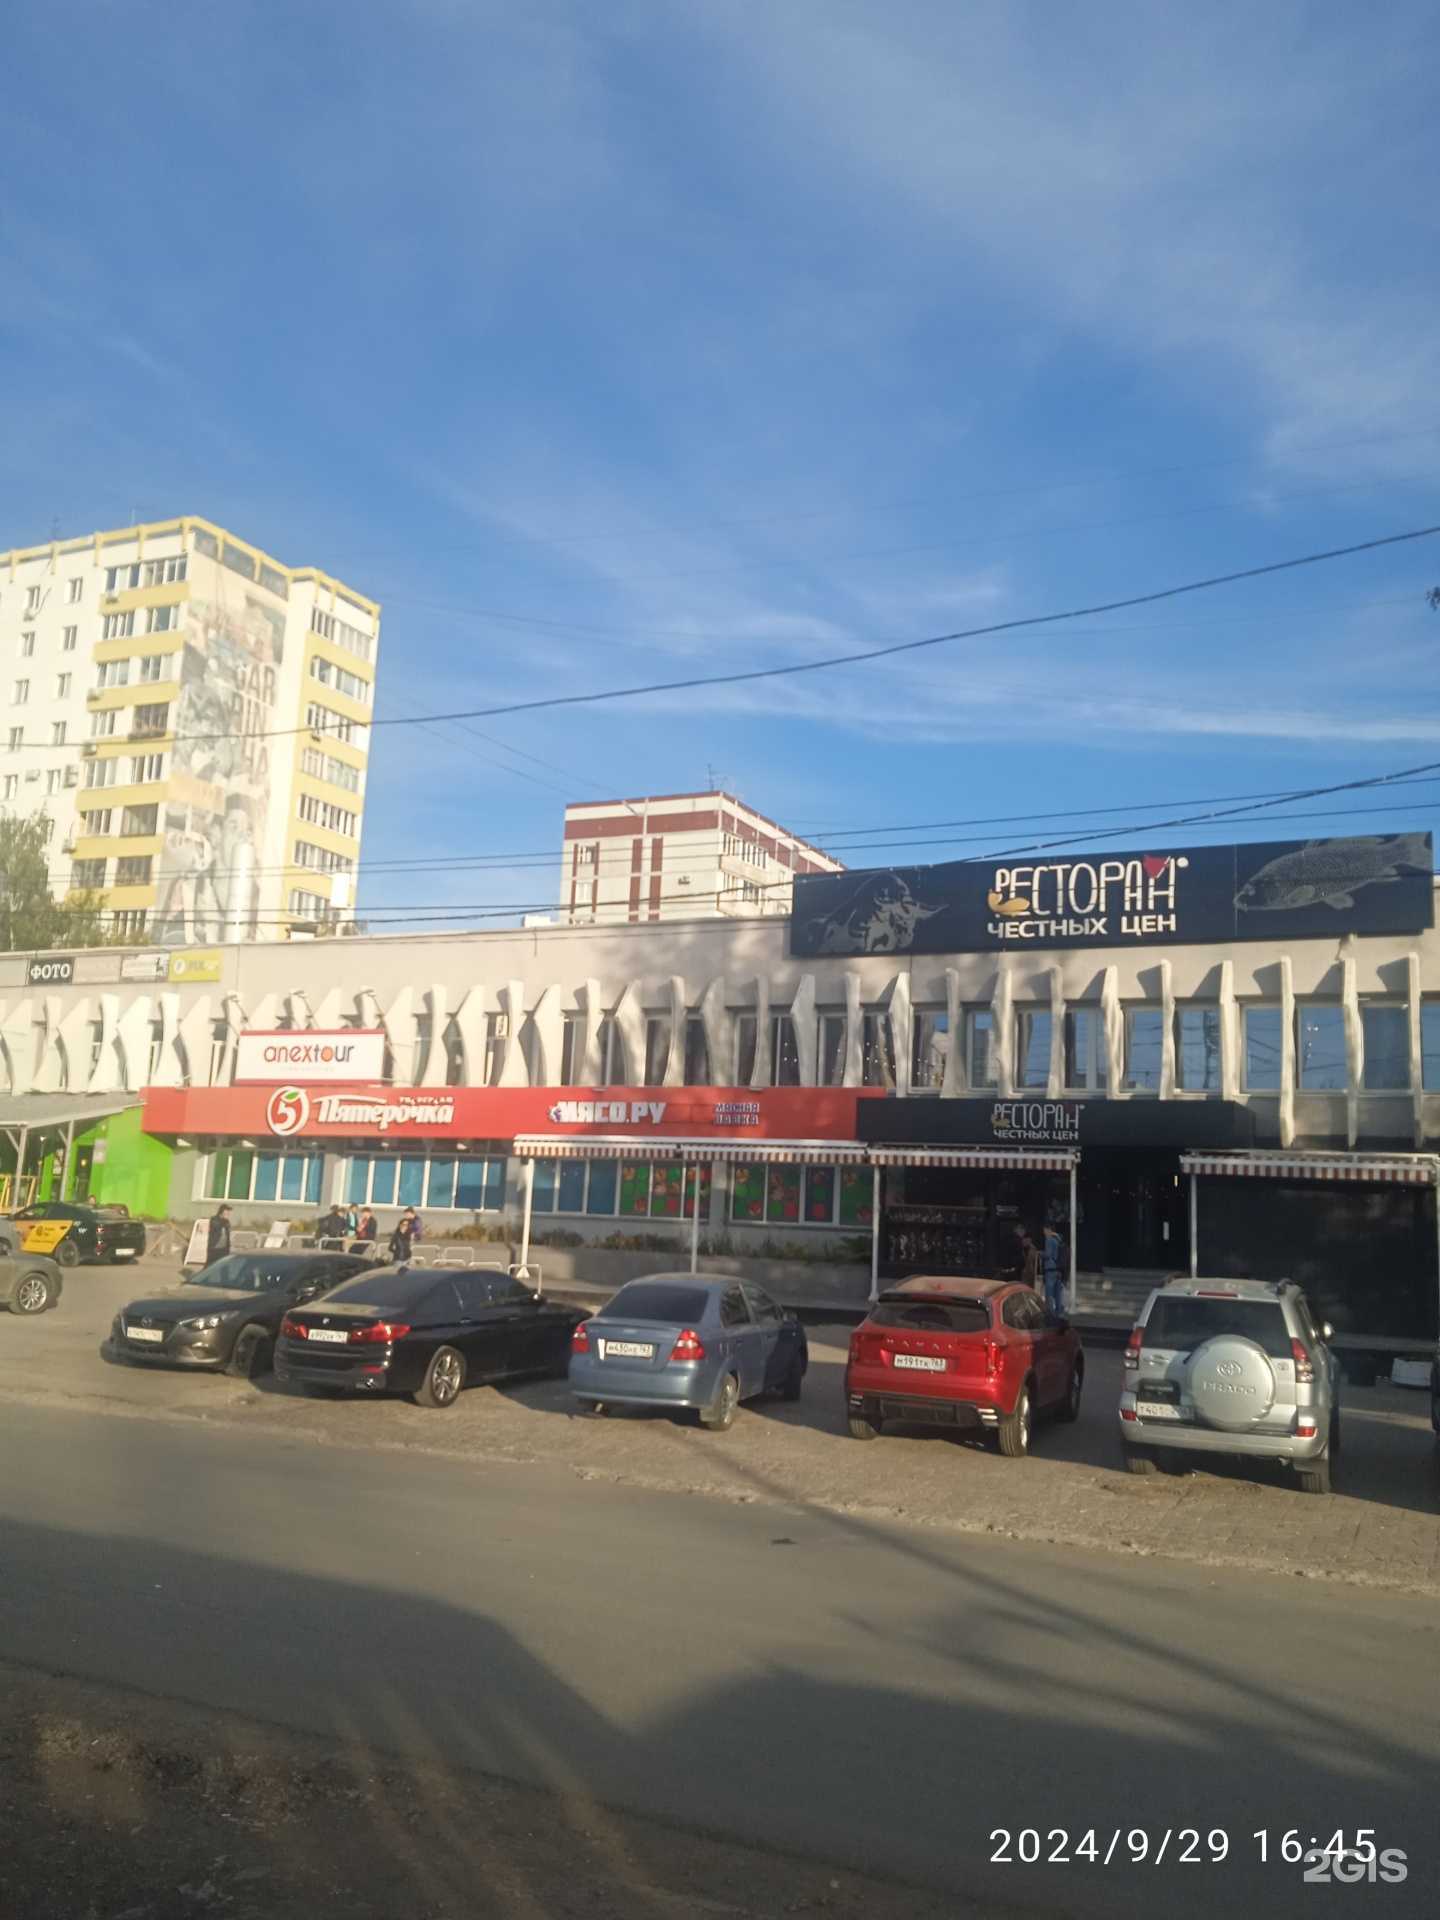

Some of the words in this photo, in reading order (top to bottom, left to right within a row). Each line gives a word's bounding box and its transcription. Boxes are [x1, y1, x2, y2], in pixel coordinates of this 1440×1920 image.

[994, 856, 1176, 917] РЕСТОРАН
[987, 917, 1109, 939] ЧЕСТНЫХ
[1121, 914, 1177, 937] ЦЕН
[30, 963, 71, 980] ФОТО
[264, 1044, 355, 1063] anextour
[272, 1099, 297, 1131] 5
[556, 1101, 666, 1124] МЯСО.РУ
[993, 1103, 1079, 1129] РЕСТОРАН
[993, 1129, 1051, 1140] ЧЕСТНЫХ
[1052, 1130, 1080, 1141] ЦЕН
